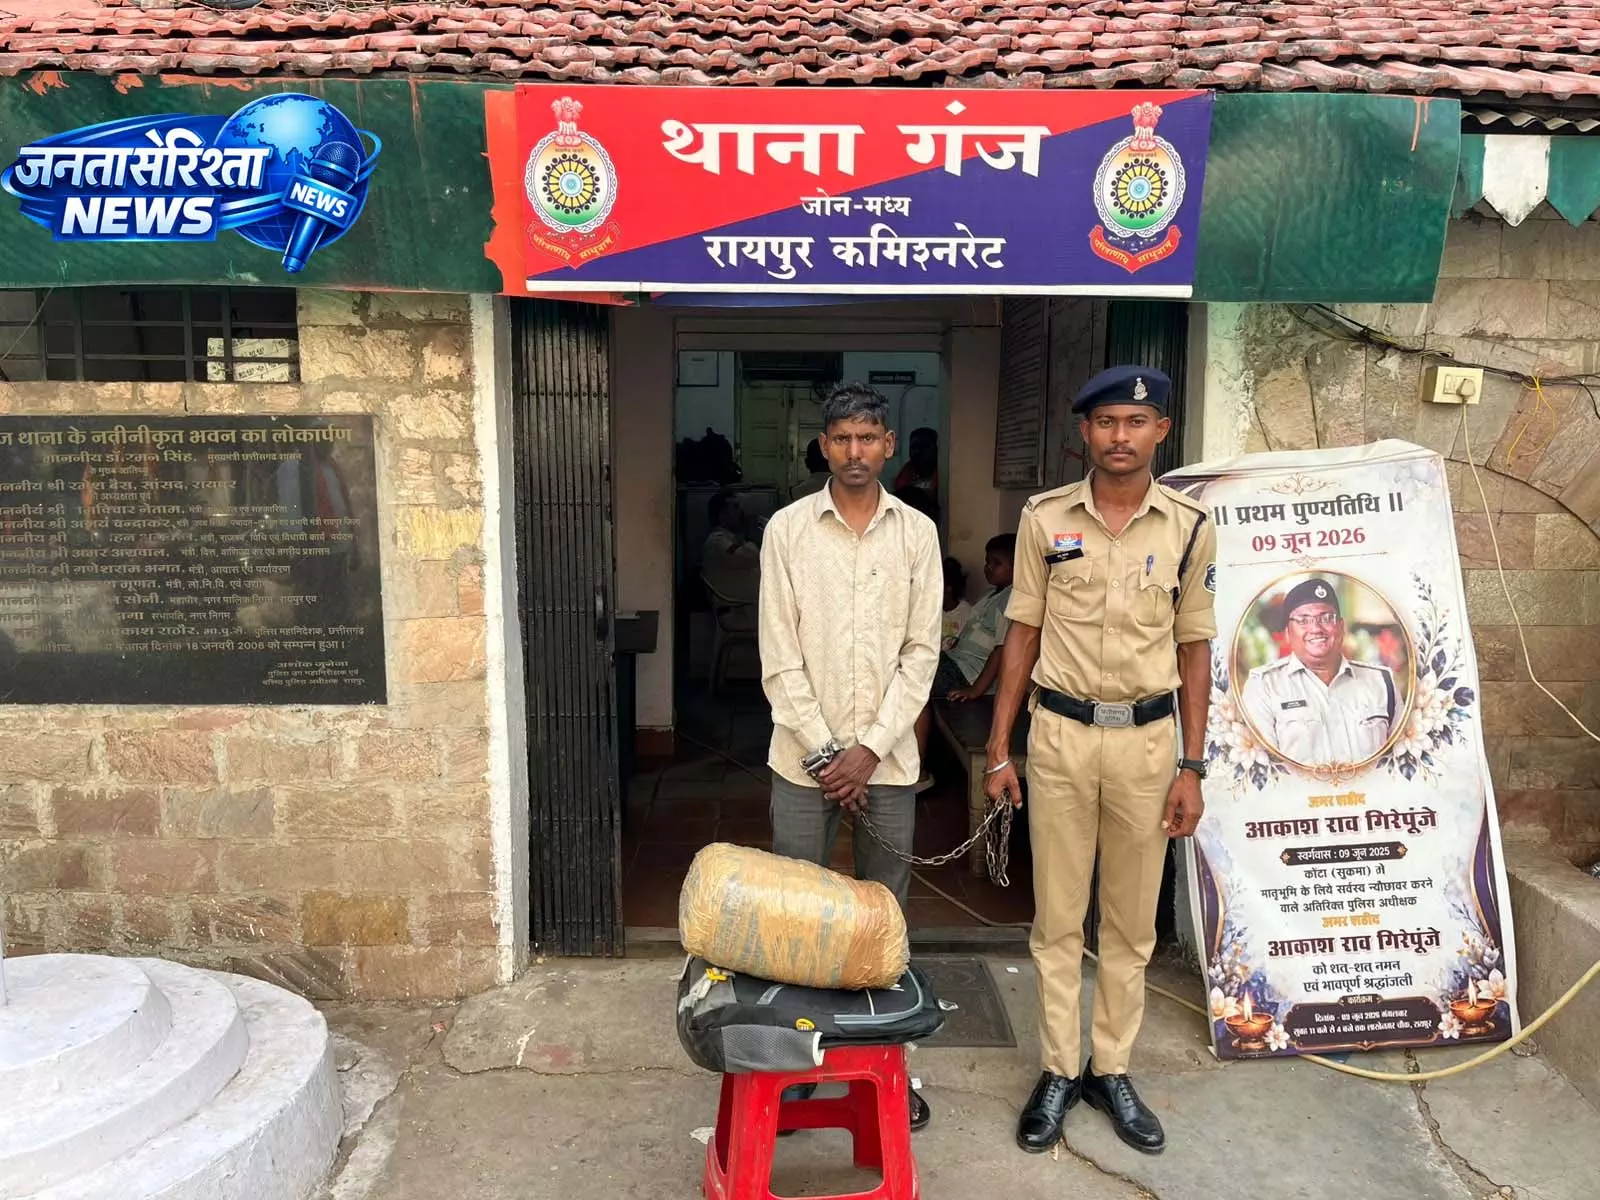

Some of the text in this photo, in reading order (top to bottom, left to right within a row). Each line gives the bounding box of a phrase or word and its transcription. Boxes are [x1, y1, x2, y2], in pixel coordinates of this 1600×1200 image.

[661, 99, 1052, 177] थाना गंज
[800, 187, 911, 217] जोन-मध्य
[703, 222, 1006, 279] रायपुर कमिश्नरेट
[18, 431, 63, 446] थाना
[68, 426, 86, 445] के
[91, 425, 185, 450] नवीनीकृत
[190, 430, 237, 444] भवन
[240, 429, 266, 443] का
[271, 424, 352, 443] लोकार्पण
[1235, 493, 1380, 525] प्रथम पुण्यतिथि
[1252, 527, 1366, 553] 09 जून 2026
[187, 641, 199, 651] 18
[201, 640, 235, 651] जनवरी
[1245, 807, 1437, 839] आकाश राव गिरेपूंजे
[1297, 846, 1391, 861] स्वर्गवास 09 जून 2025
[1260, 885, 1297, 900] मातृभूमि
[1300, 883, 1310, 896] के
[1314, 883, 1333, 895] लिये
[1411, 876, 1434, 889] करने
[1280, 901, 1299, 913] वाले
[1348, 897, 1375, 912] पुलिस
[1379, 894, 1418, 908] अधीक्षक
[1268, 927, 1441, 957] आकाश राव गिरेपूंजे
[1312, 961, 1326, 975] को
[1375, 959, 1401, 971] नमन
[1303, 980, 1319, 993] एवं
[1322, 974, 1361, 996] भावपूर्ण
